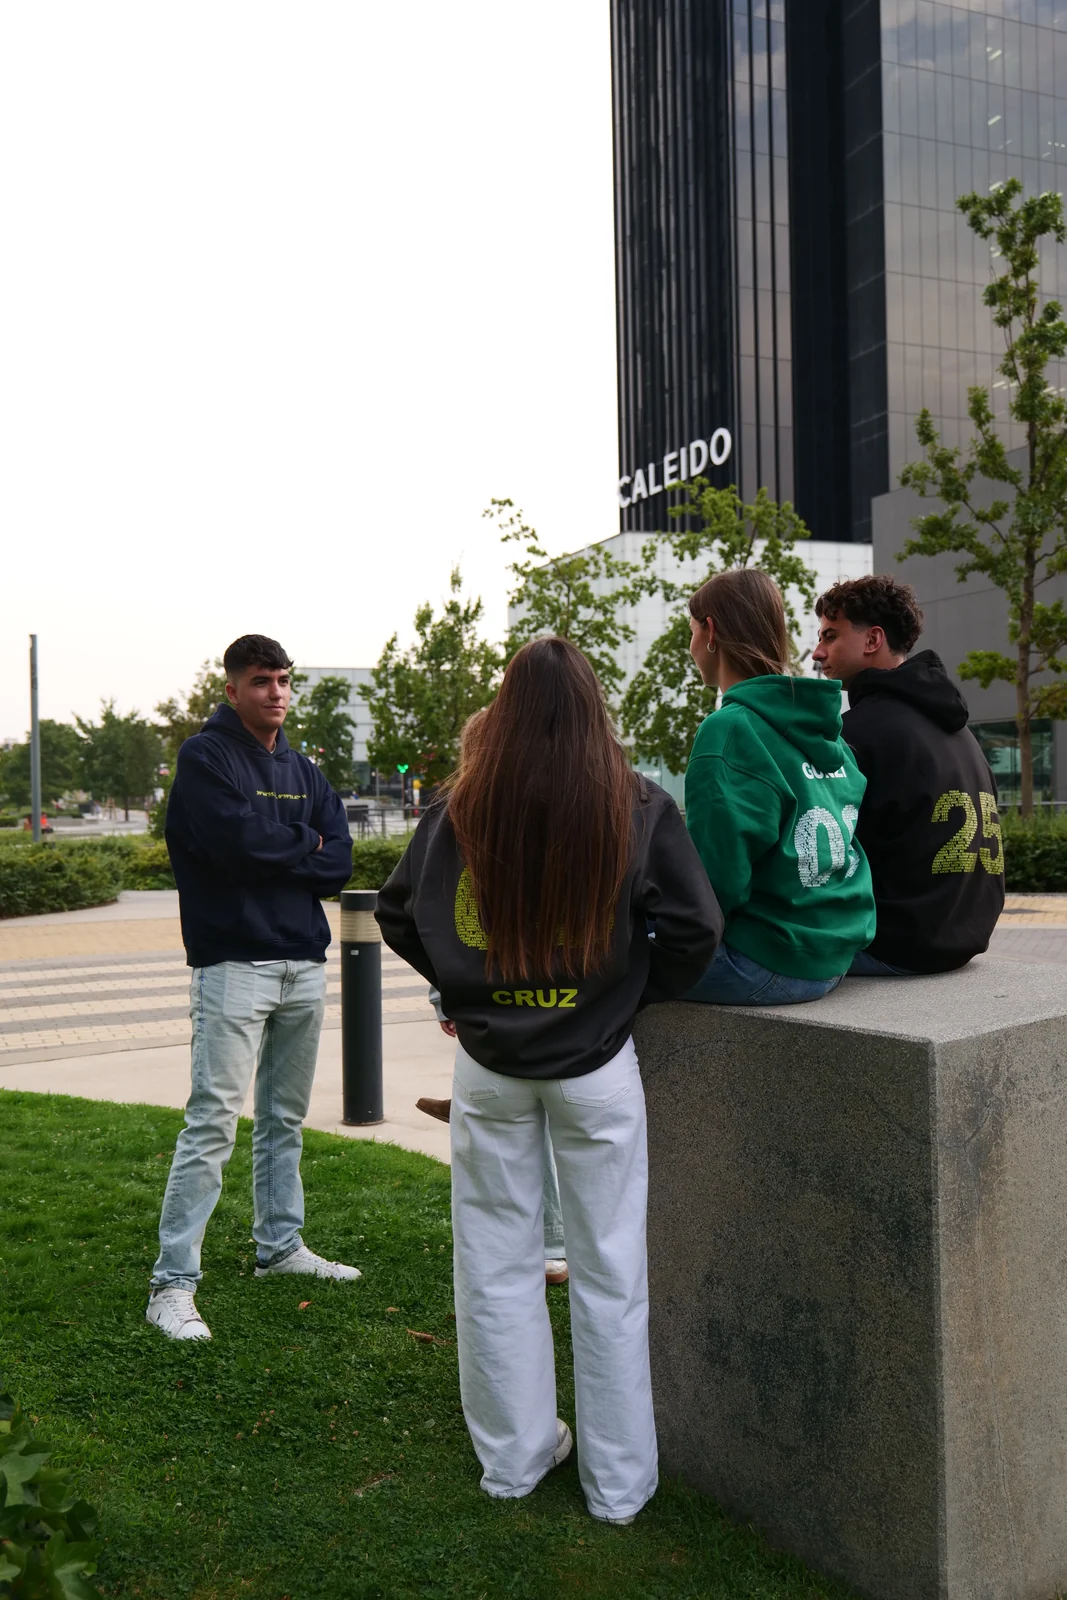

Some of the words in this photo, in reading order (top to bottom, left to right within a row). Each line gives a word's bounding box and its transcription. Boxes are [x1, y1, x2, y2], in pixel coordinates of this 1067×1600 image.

[617, 427, 732, 508] CALEIDO
[931, 790, 1005, 875] 25
[491, 988, 578, 1008] CRUZ
